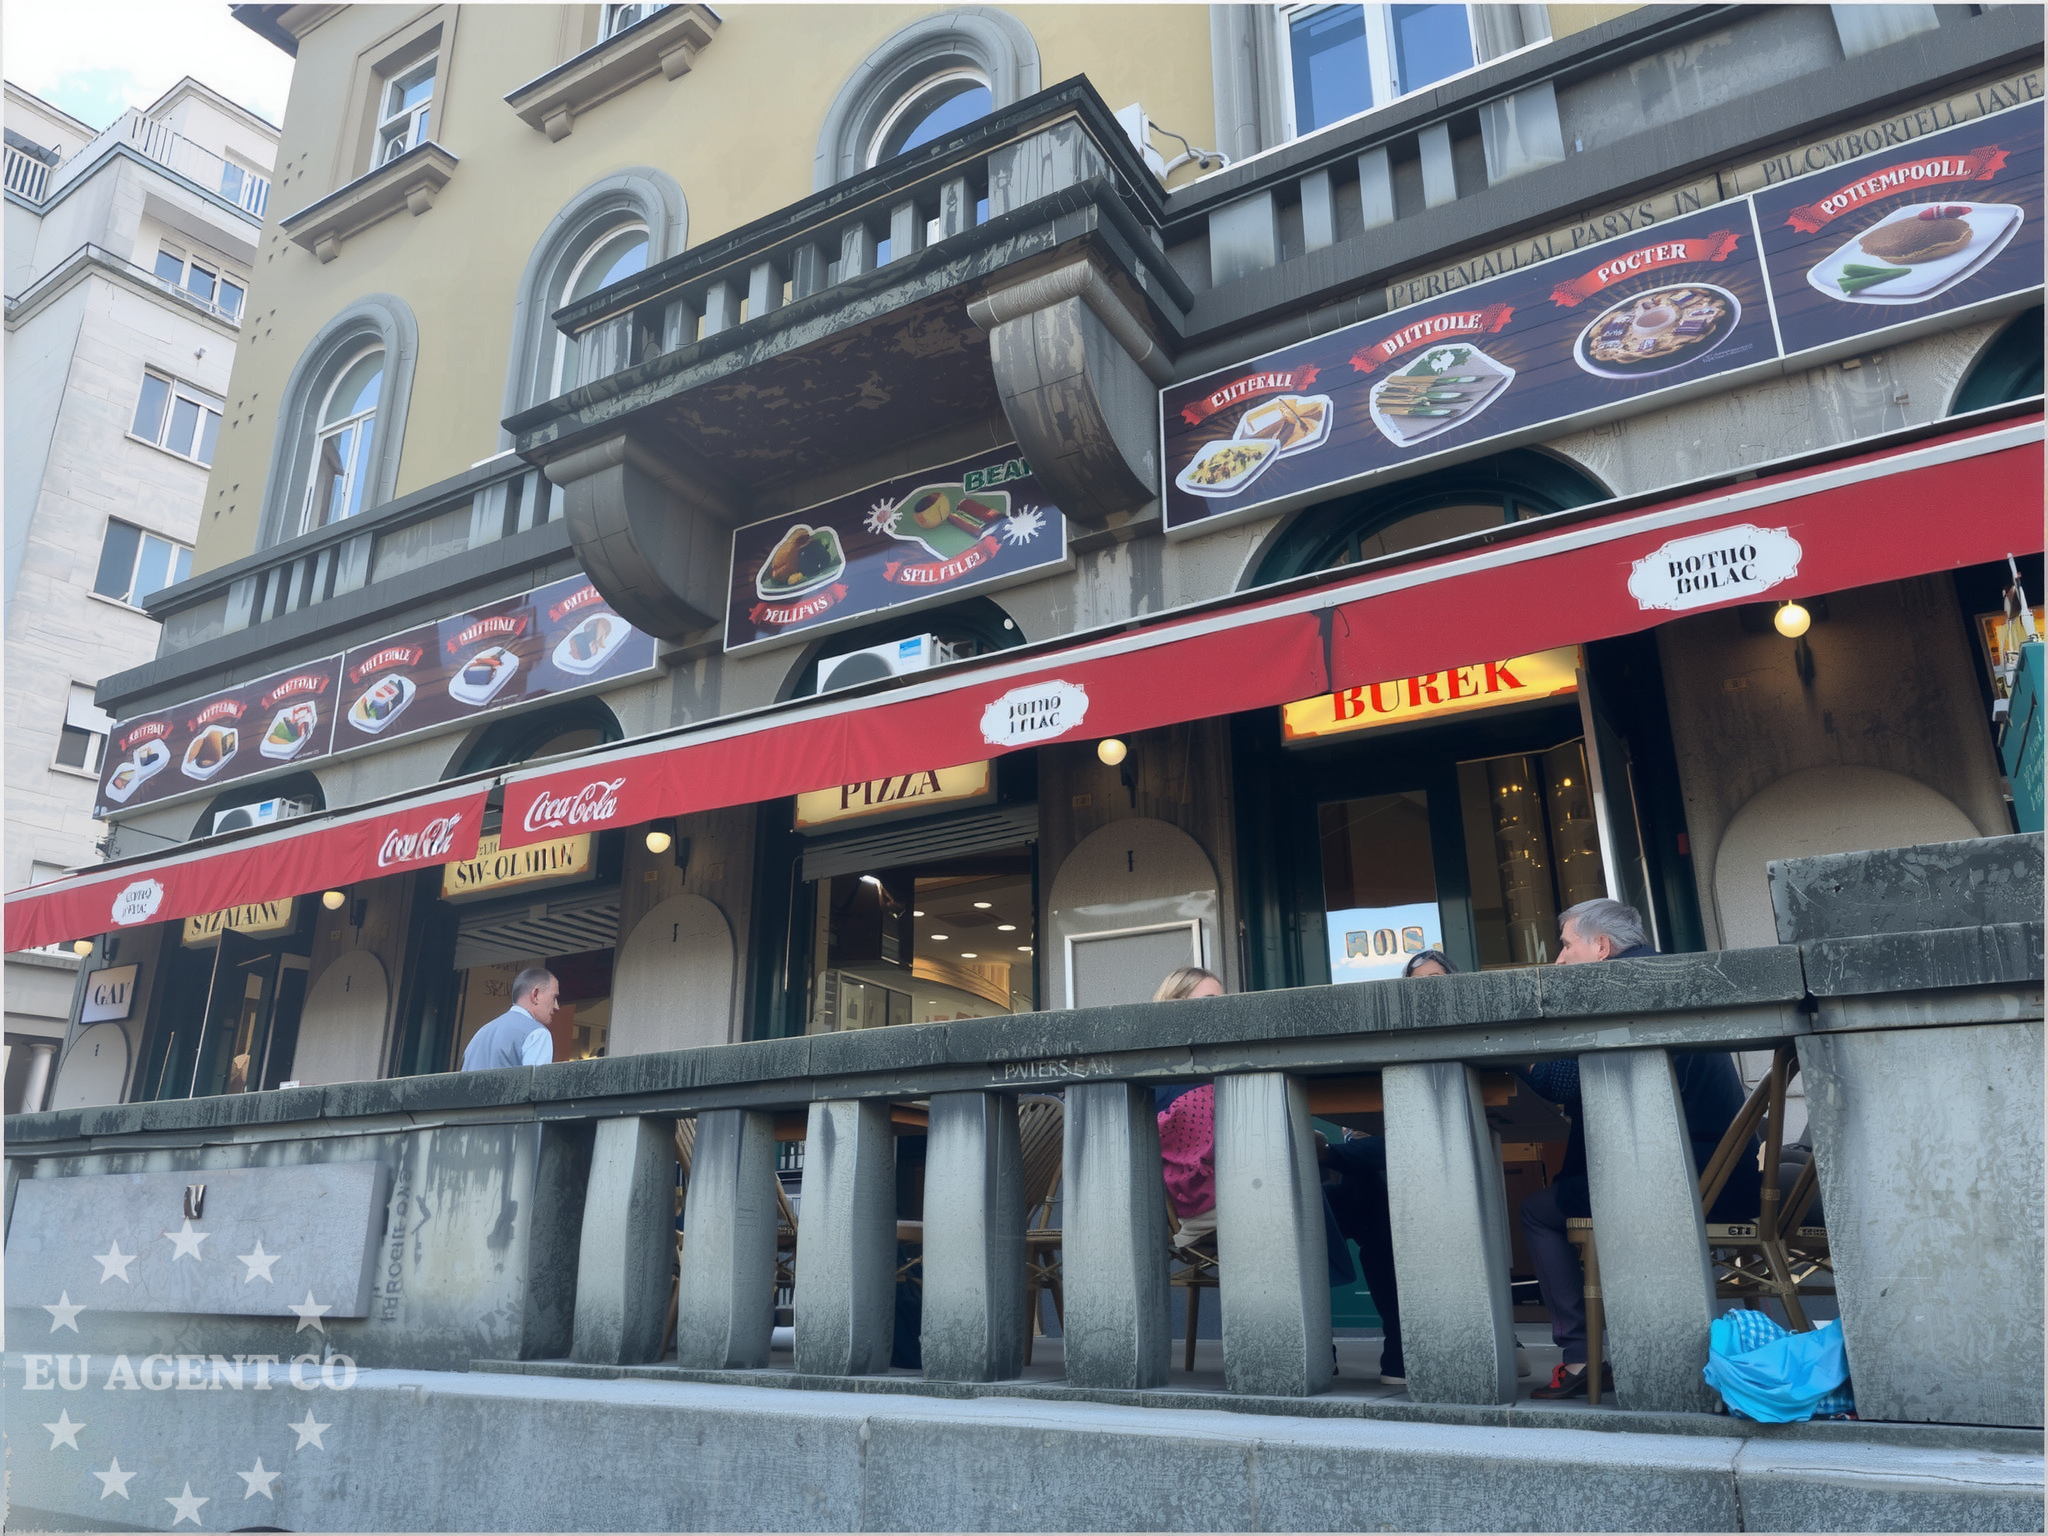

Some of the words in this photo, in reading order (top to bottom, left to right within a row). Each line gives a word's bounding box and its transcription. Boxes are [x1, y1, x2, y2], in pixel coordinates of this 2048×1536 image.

[1597, 243, 1688, 284] POCTER
[1333, 657, 1527, 722] BUREK
[839, 769, 943, 810] PIZZA
